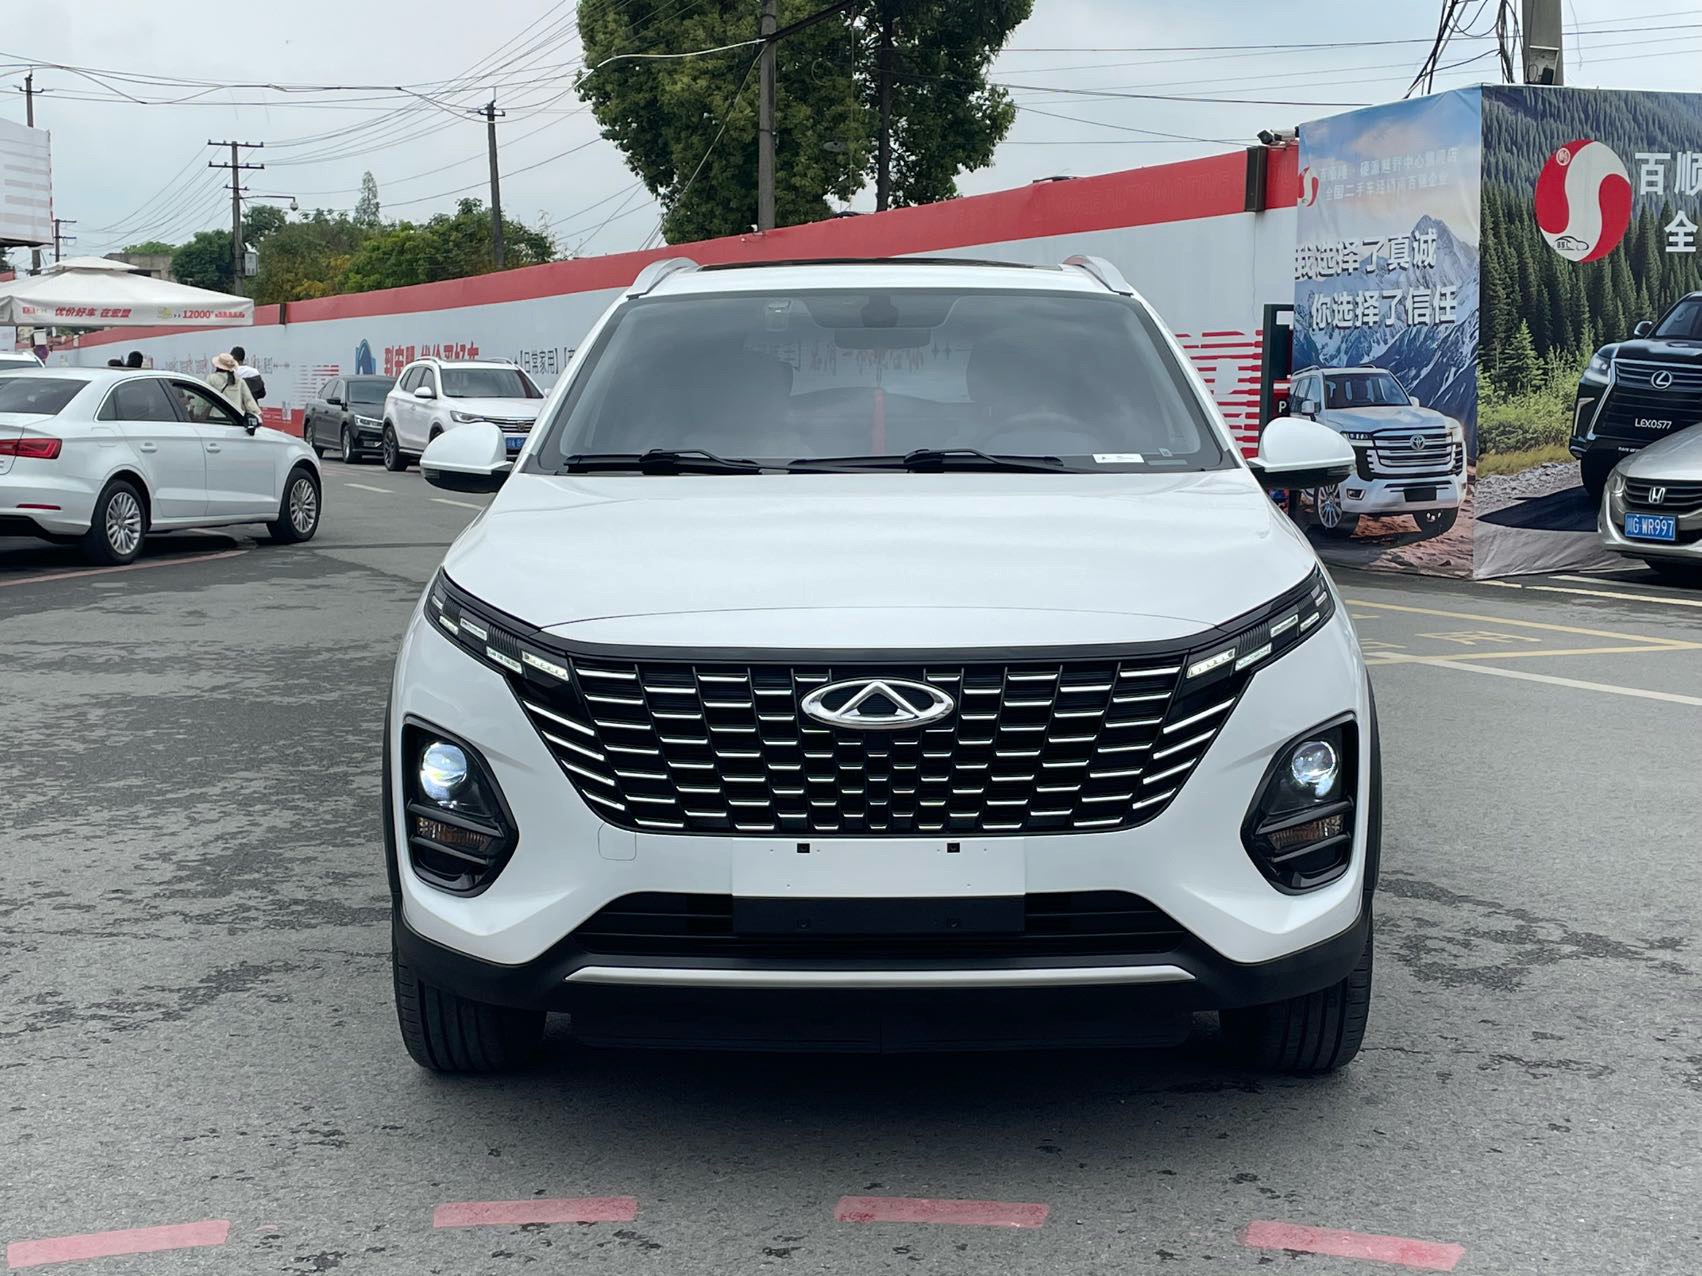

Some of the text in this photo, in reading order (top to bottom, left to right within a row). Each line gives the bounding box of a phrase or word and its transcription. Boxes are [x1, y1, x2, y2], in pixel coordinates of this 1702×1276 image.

[1295, 228, 1438, 281] 我选择了真诚
[1663, 210, 1699, 253] 全
[1311, 285, 1459, 331] 你选择了信任
